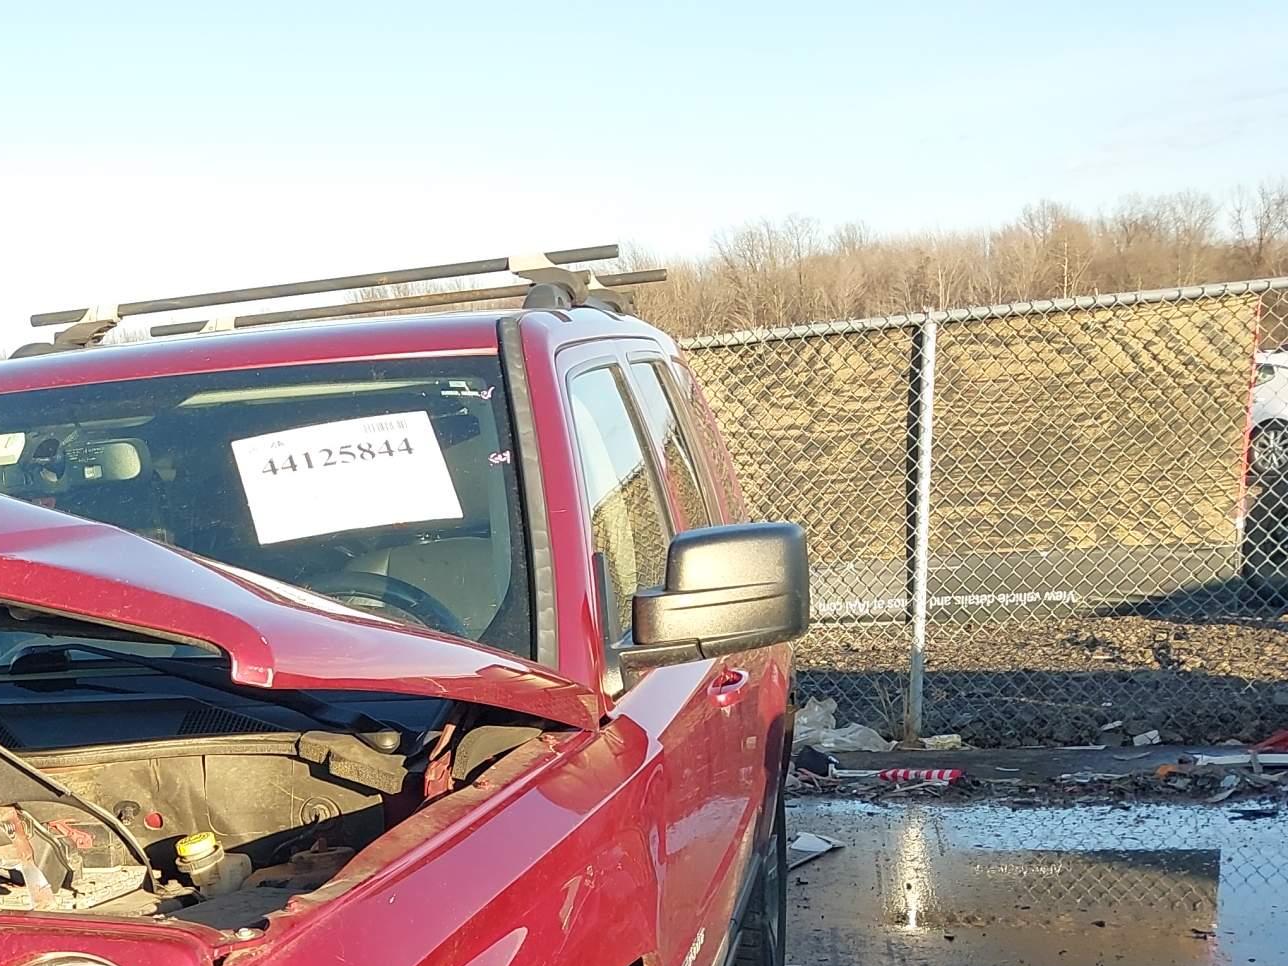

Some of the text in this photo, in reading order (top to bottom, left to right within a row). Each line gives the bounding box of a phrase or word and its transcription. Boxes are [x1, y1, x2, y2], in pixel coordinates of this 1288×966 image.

[262, 437, 414, 476] 44125844
[929, 595, 952, 609] and
[955, 593, 995, 608] details
